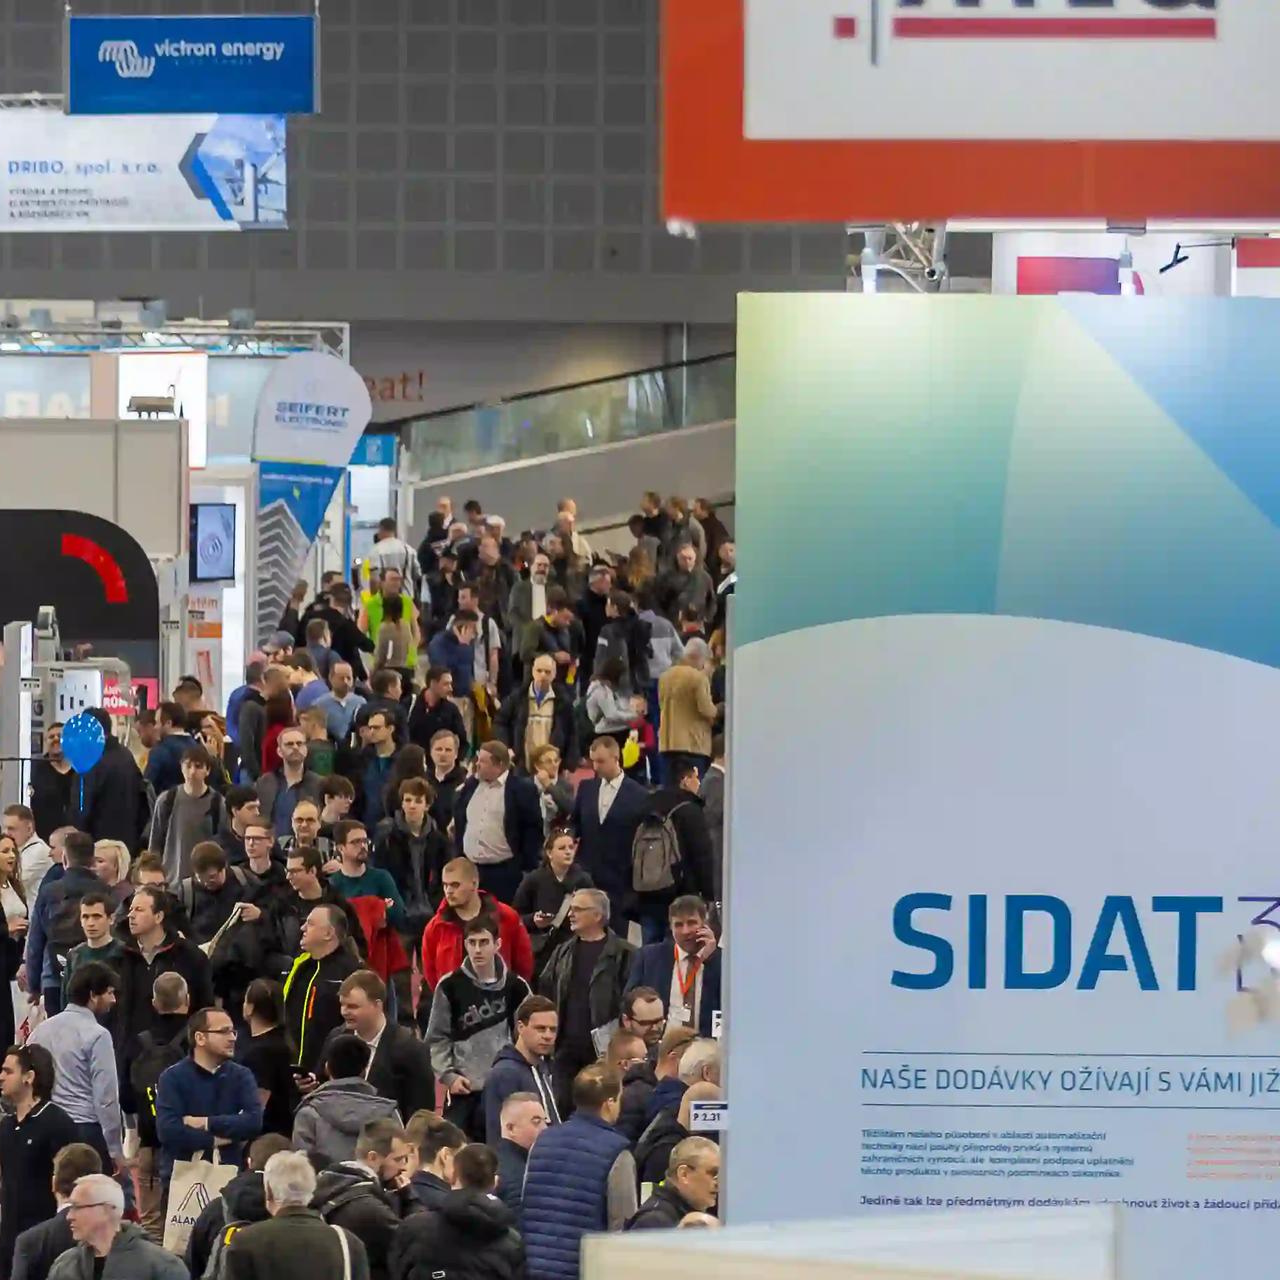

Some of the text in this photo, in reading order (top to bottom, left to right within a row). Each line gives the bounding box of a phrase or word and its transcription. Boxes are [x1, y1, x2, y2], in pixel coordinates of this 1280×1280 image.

[155, 38, 285, 61] victron energy
[276, 401, 350, 418] SEIFERT
[890, 891, 1224, 992] SIDAT
[861, 1064, 927, 1091] NAŠE
[936, 1065, 1053, 1092] DODÁVKY
[1060, 1066, 1152, 1096] OŽÍVAJÍ
[1158, 1071, 1171, 1092] S
[1179, 1067, 1242, 1094] VÁMI
